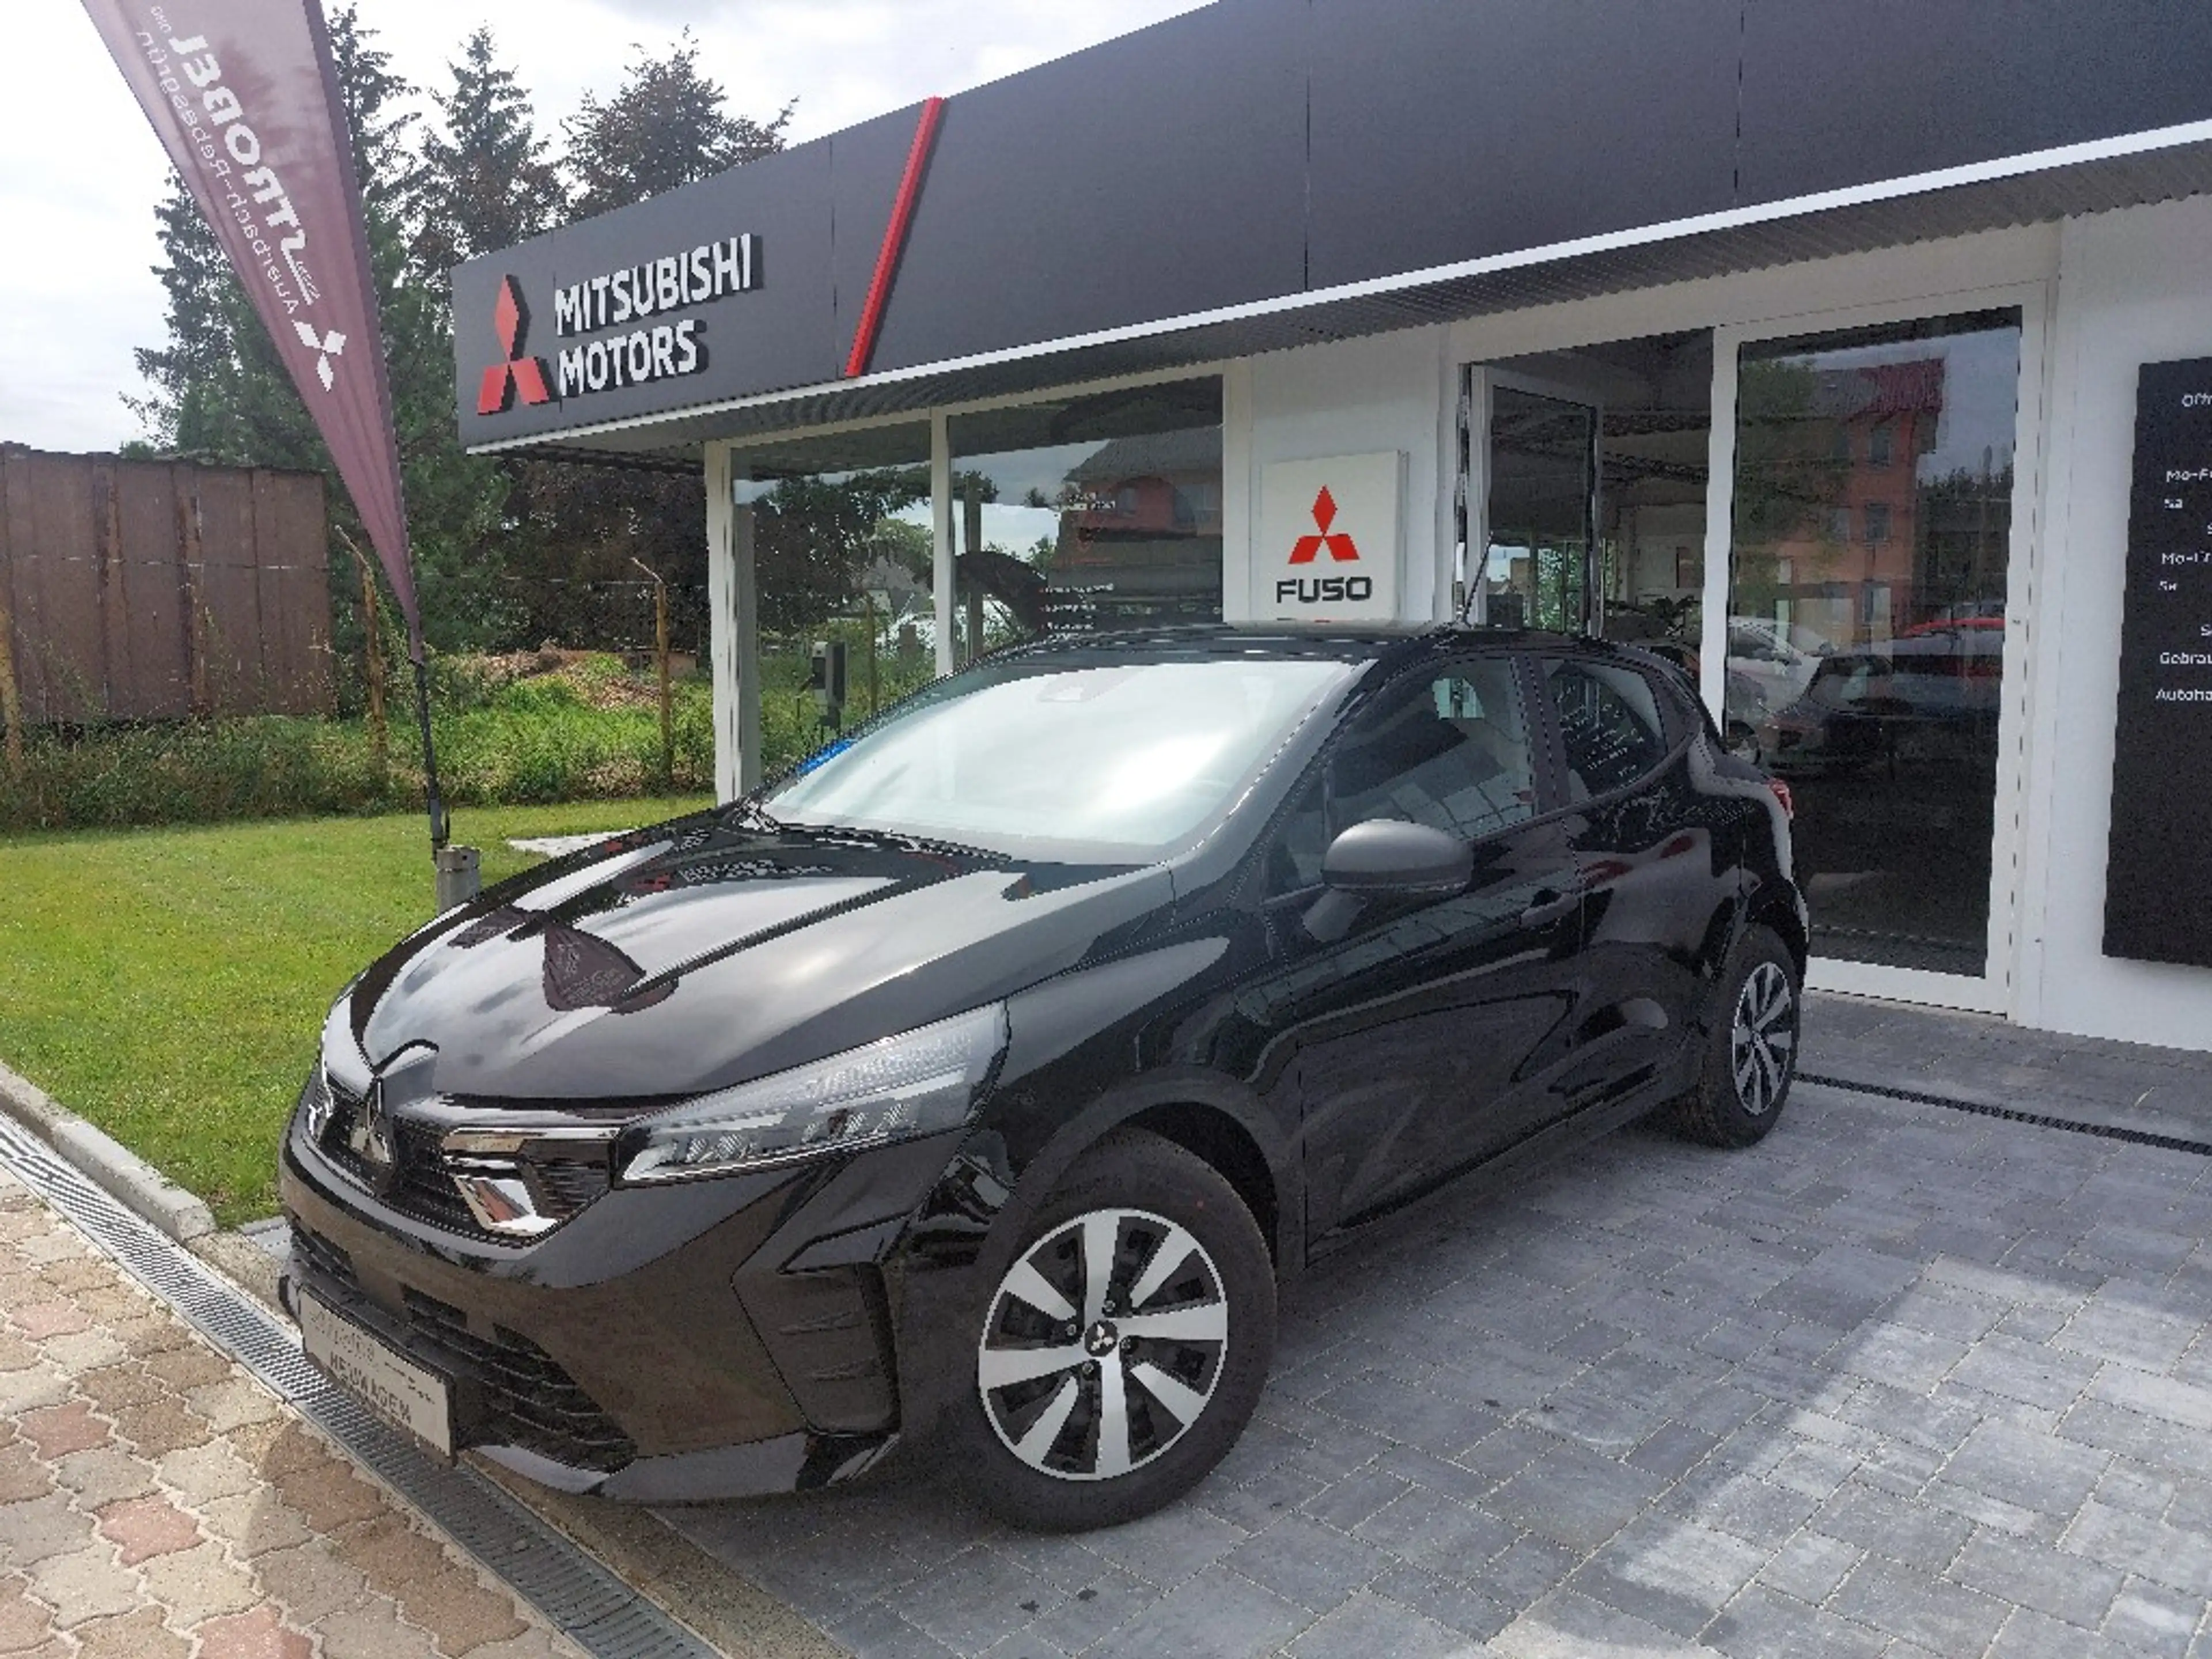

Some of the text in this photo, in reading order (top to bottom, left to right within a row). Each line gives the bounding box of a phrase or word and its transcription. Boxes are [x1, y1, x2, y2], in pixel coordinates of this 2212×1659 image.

[555, 233, 752, 336] MITSUBISHI
[558, 320, 697, 397] MOTORS
[1276, 576, 1373, 604] FUSO
